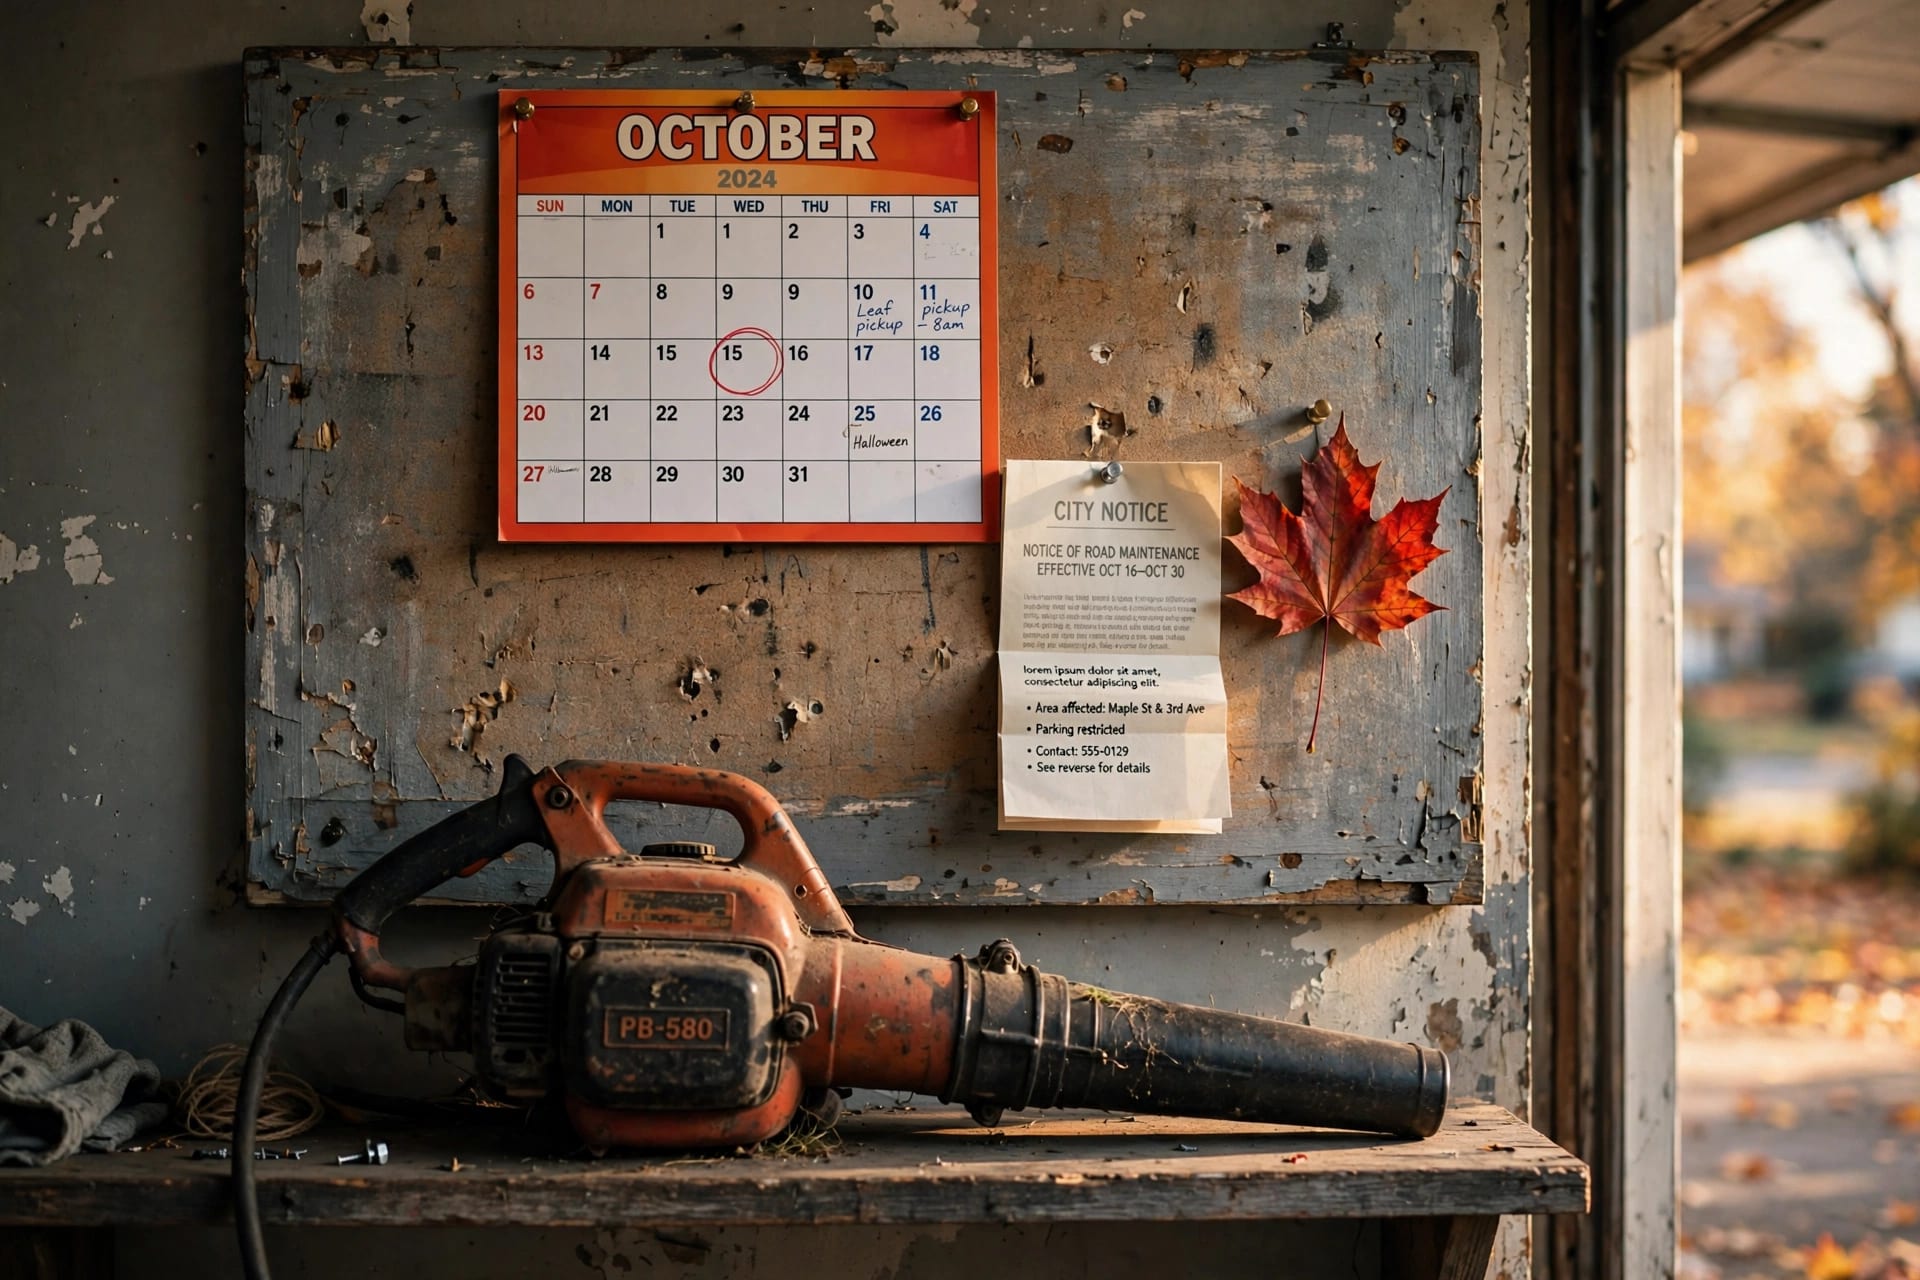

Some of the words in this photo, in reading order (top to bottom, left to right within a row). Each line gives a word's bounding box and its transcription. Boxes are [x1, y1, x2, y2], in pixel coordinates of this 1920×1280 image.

[617, 114, 877, 160] OCTOBER
[717, 169, 777, 188] 2024
[537, 200, 564, 213] SUN
[602, 200, 633, 213] MON
[669, 200, 696, 213] TUE
[734, 200, 765, 213] WED
[801, 200, 829, 213] THU
[871, 200, 891, 213] FRI
[934, 200, 959, 213] SAT
[656, 223, 664, 240] 1
[722, 223, 730, 240] 1
[788, 223, 800, 240] 2
[853, 223, 865, 240] 3
[919, 224, 931, 240] 4
[523, 284, 535, 301] 6
[589, 284, 602, 301] 7
[655, 284, 668, 301] 8
[721, 284, 734, 301] 9
[787, 284, 800, 301] 9
[853, 284, 874, 301] 10
[919, 284, 936, 301] 11
[856, 300, 894, 318] Leaf
[922, 299, 970, 320] pickup
[855, 318, 903, 337] pickup
[933, 317, 965, 331] 8am
[523, 345, 544, 362] 13
[590, 345, 611, 362] 14
[656, 345, 677, 362] 15
[722, 345, 743, 362] 15
[788, 345, 809, 362] 16
[853, 345, 874, 362] 17
[920, 345, 941, 362] 18
[523, 405, 546, 422] 20
[589, 405, 609, 422] 21
[655, 405, 678, 422] 22
[722, 405, 745, 422] 23
[788, 405, 811, 422] 24
[854, 405, 876, 422] 25
[920, 405, 943, 422] 26
[853, 435, 909, 449] Halloween
[523, 466, 545, 483] 27
[589, 466, 612, 483] 28
[655, 466, 679, 483] 29
[721, 466, 745, 483] 30
[788, 466, 808, 483] 31
[1054, 501, 1094, 521] CITY
[1101, 502, 1169, 522] NOTICE
[1023, 544, 1063, 558] NOTICE
[1066, 545, 1081, 558] OF
[1085, 546, 1115, 559] ROAD
[1119, 546, 1200, 560] MAINTENANCE
[1037, 563, 1095, 576] EFFECTIVE
[1099, 564, 1121, 577] OCT
[1171, 565, 1185, 578] 30
[1024, 665, 1052, 674] lorem
[1054, 665, 1085, 676] ipsum
[1088, 666, 1114, 676] dolor
[1117, 666, 1129, 676] sit
[1131, 667, 1161, 677] amet,
[1024, 678, 1083, 686] consectetur
[1087, 678, 1137, 689] adipiscing
[1140, 678, 1159, 687] elit.
[1035, 702, 1058, 713] Area
[1061, 701, 1106, 714] affected:
[1108, 703, 1139, 716] Maple
[1142, 703, 1152, 714] St
[1155, 704, 1163, 714] &
[1166, 703, 1183, 714] 3rd
[1186, 703, 1205, 714] Ave
[1035, 724, 1074, 736] Parking
[1077, 724, 1125, 735] restricted
[1036, 746, 1078, 756] Contact:
[1081, 746, 1129, 757] 555-0129
[1037, 762, 1055, 773] See
[1058, 763, 1095, 773] reverse
[1098, 762, 1114, 773] for
[1117, 762, 1151, 774] details
[619, 1015, 714, 1040] PB-580
